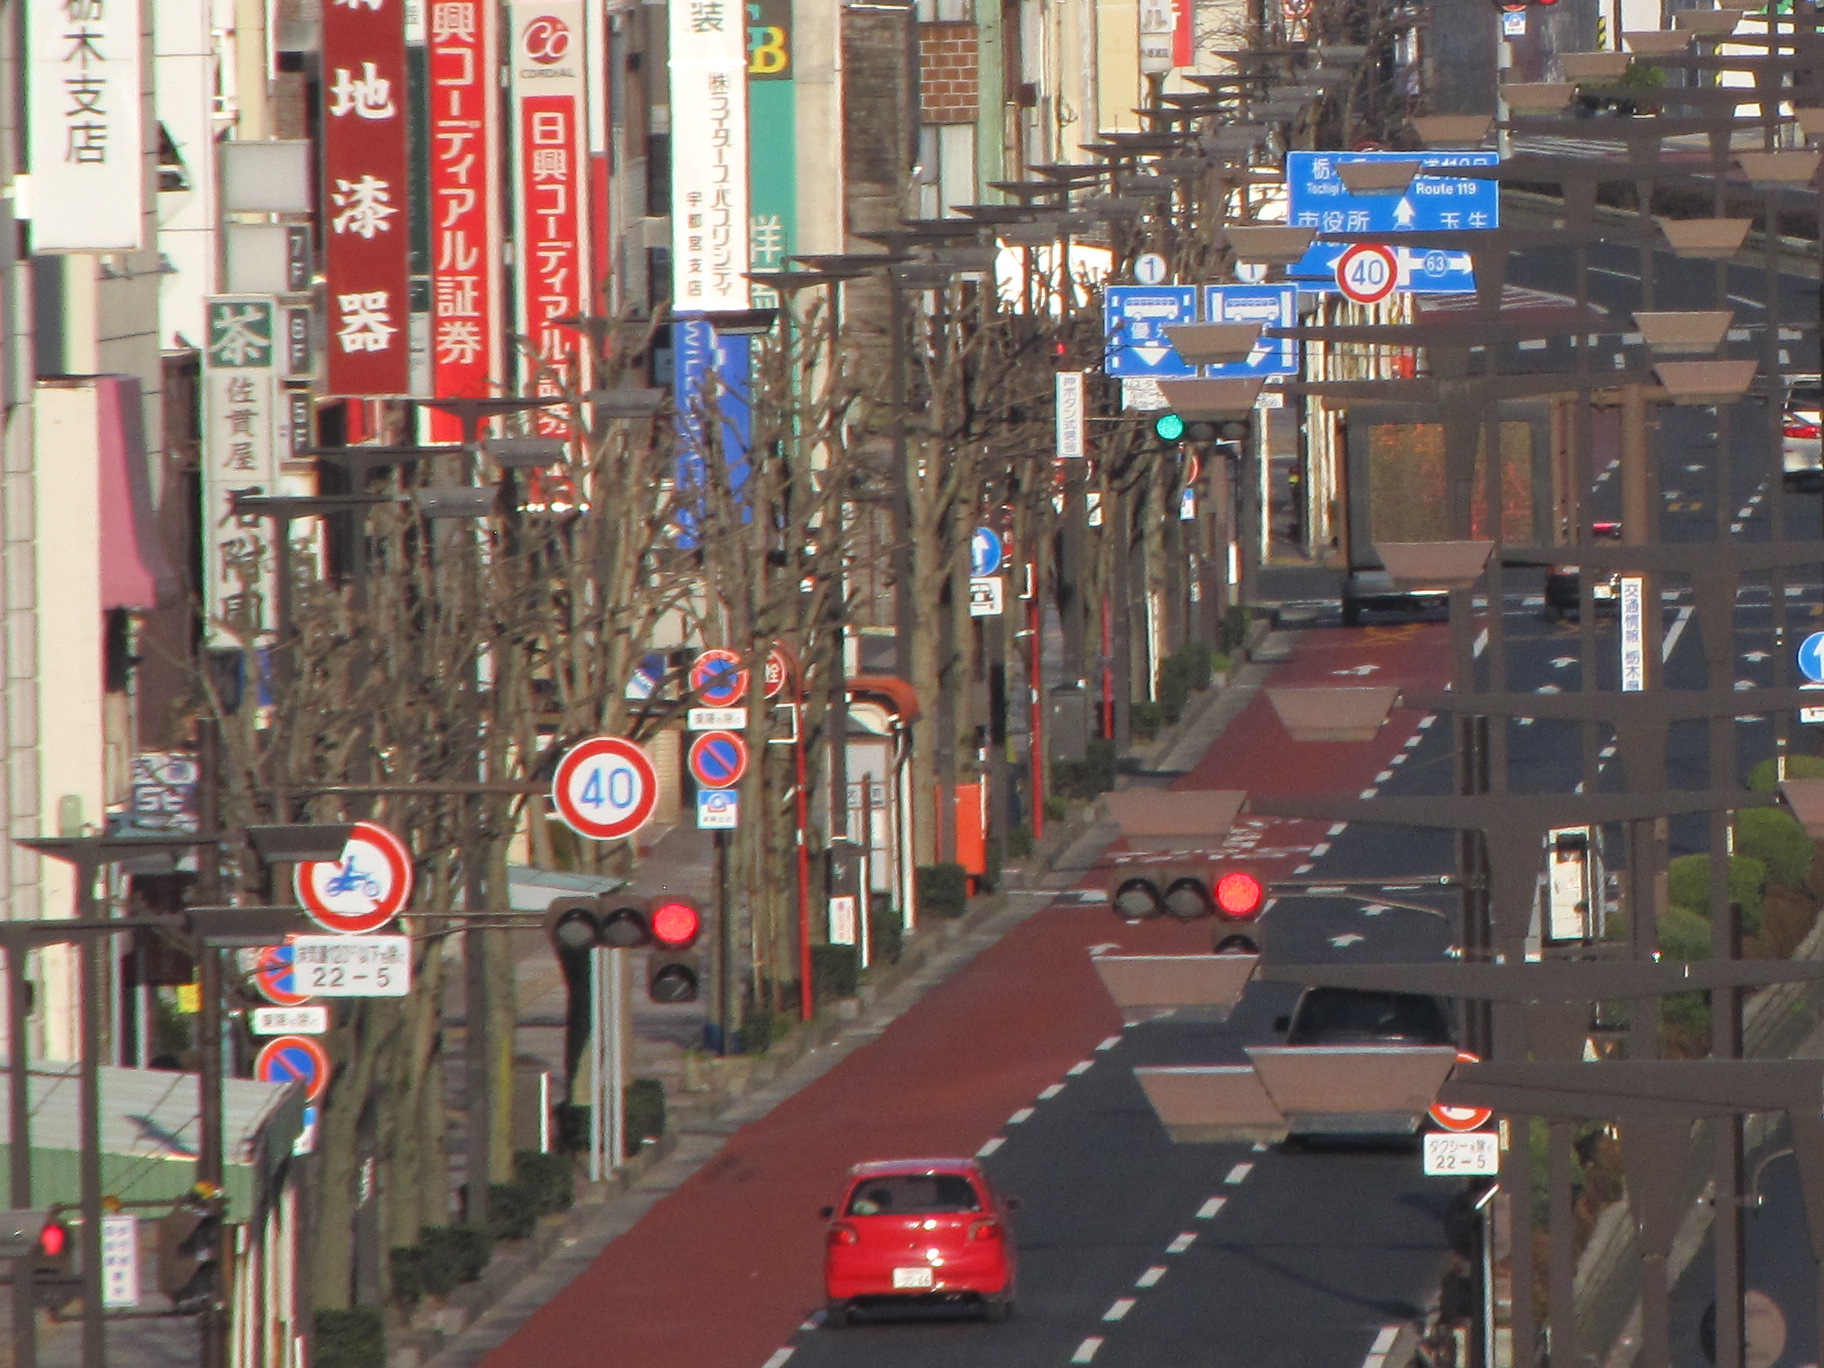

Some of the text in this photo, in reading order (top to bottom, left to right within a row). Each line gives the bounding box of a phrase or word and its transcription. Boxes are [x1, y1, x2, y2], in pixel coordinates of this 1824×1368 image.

[1416, 182, 1477, 196] Route 119
[1350, 259, 1385, 286] 40
[1426, 257, 1446, 273] 63
[208, 304, 271, 367] 茶
[579, 766, 635, 810] 40
